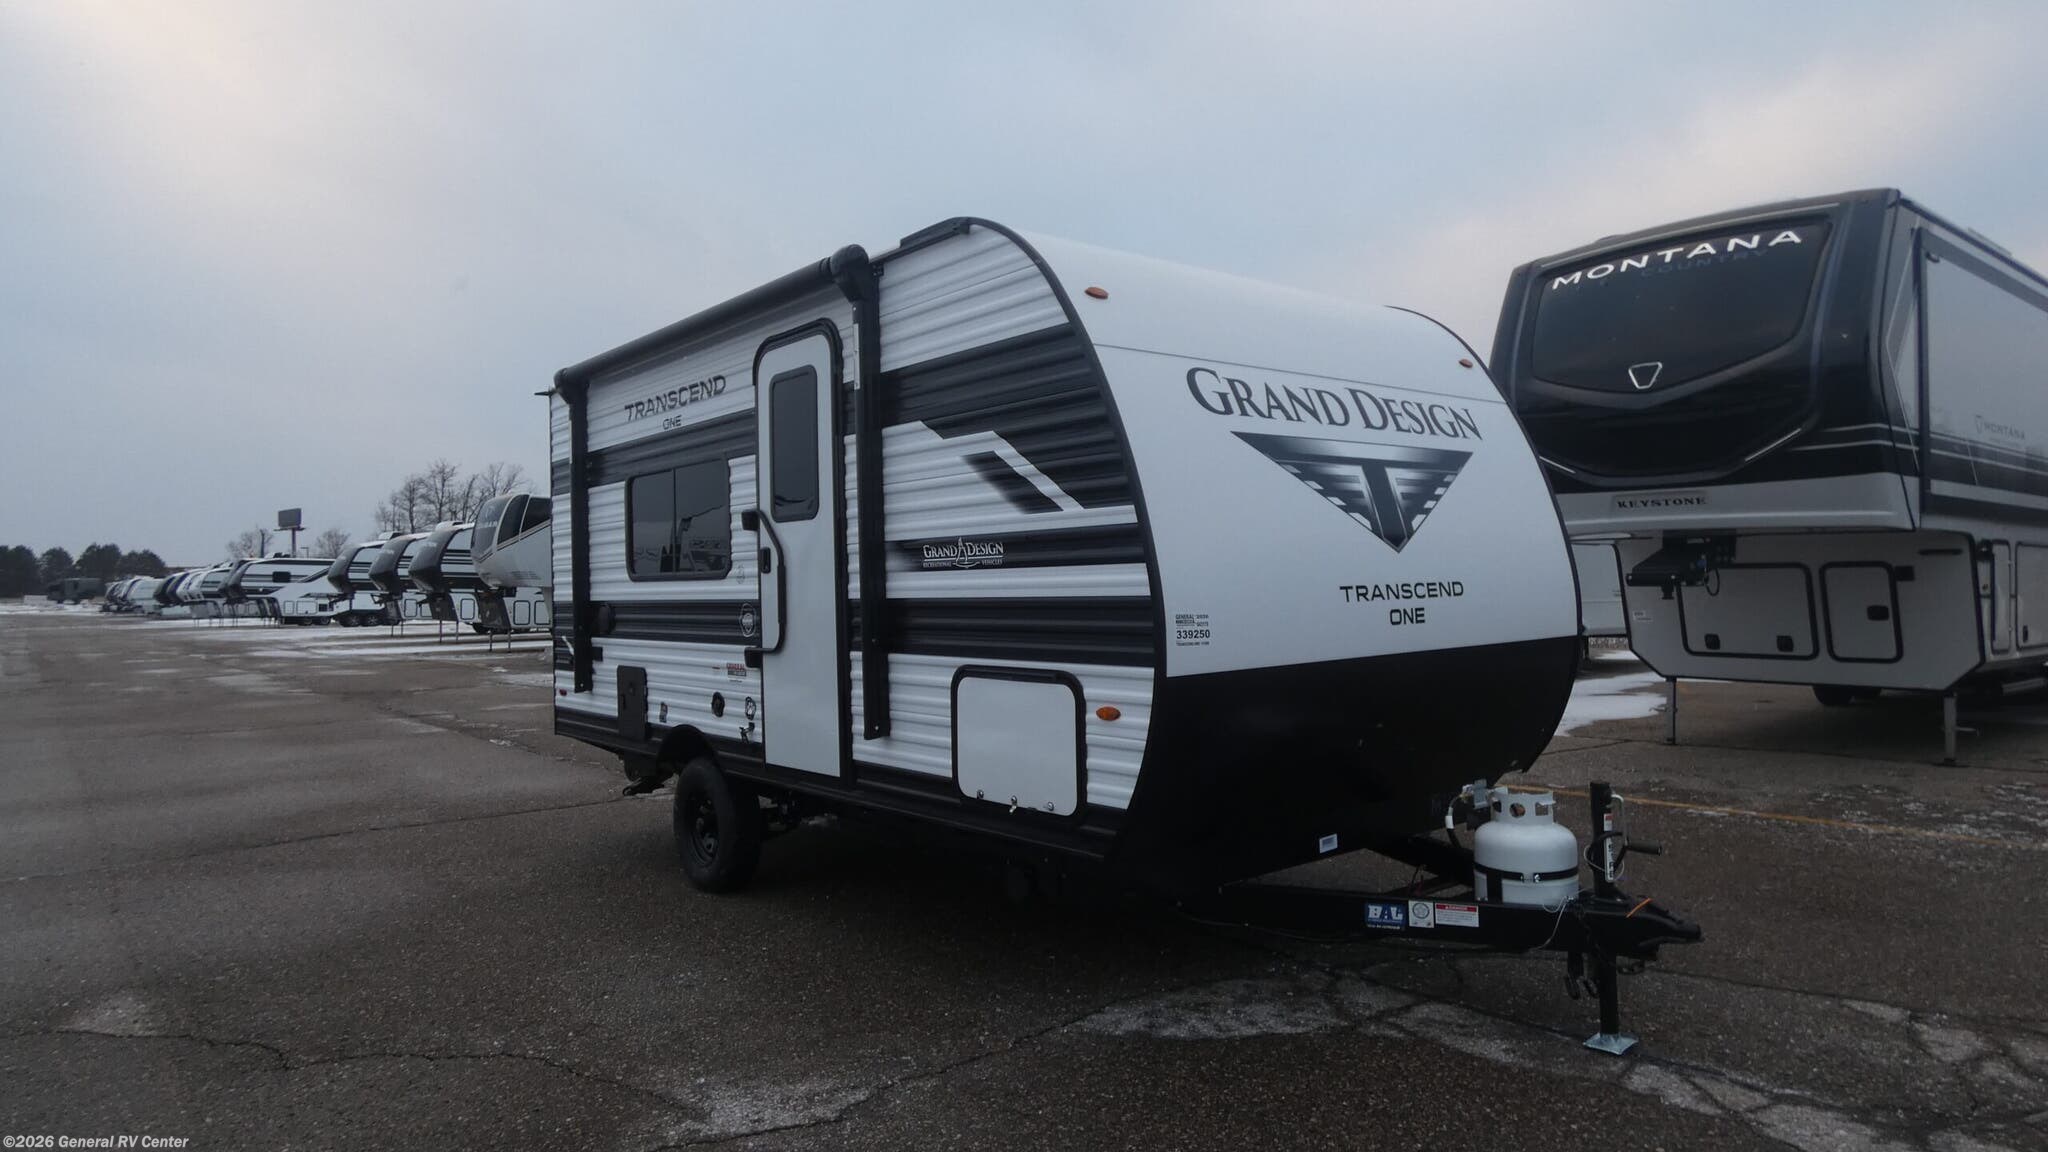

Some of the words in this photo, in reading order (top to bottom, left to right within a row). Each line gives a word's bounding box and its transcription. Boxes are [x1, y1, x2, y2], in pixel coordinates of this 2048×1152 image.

[1552, 231, 1802, 290] MONTANA
[624, 375, 726, 421] TRANSCEND
[1186, 367, 1351, 426] GRAND
[1344, 387, 1483, 440] DESIGN
[662, 415, 682, 430] ONE
[1984, 421, 2025, 440] MONTANA
[1617, 497, 1706, 508] KEYSTONE
[923, 544, 957, 558] GRAND
[965, 542, 1004, 556] DESIGN
[1339, 581, 1464, 602] TRANSCEND
[1389, 607, 1425, 625] ONE
[1176, 629, 1210, 639] 339250
[1368, 905, 1404, 920] BAL
